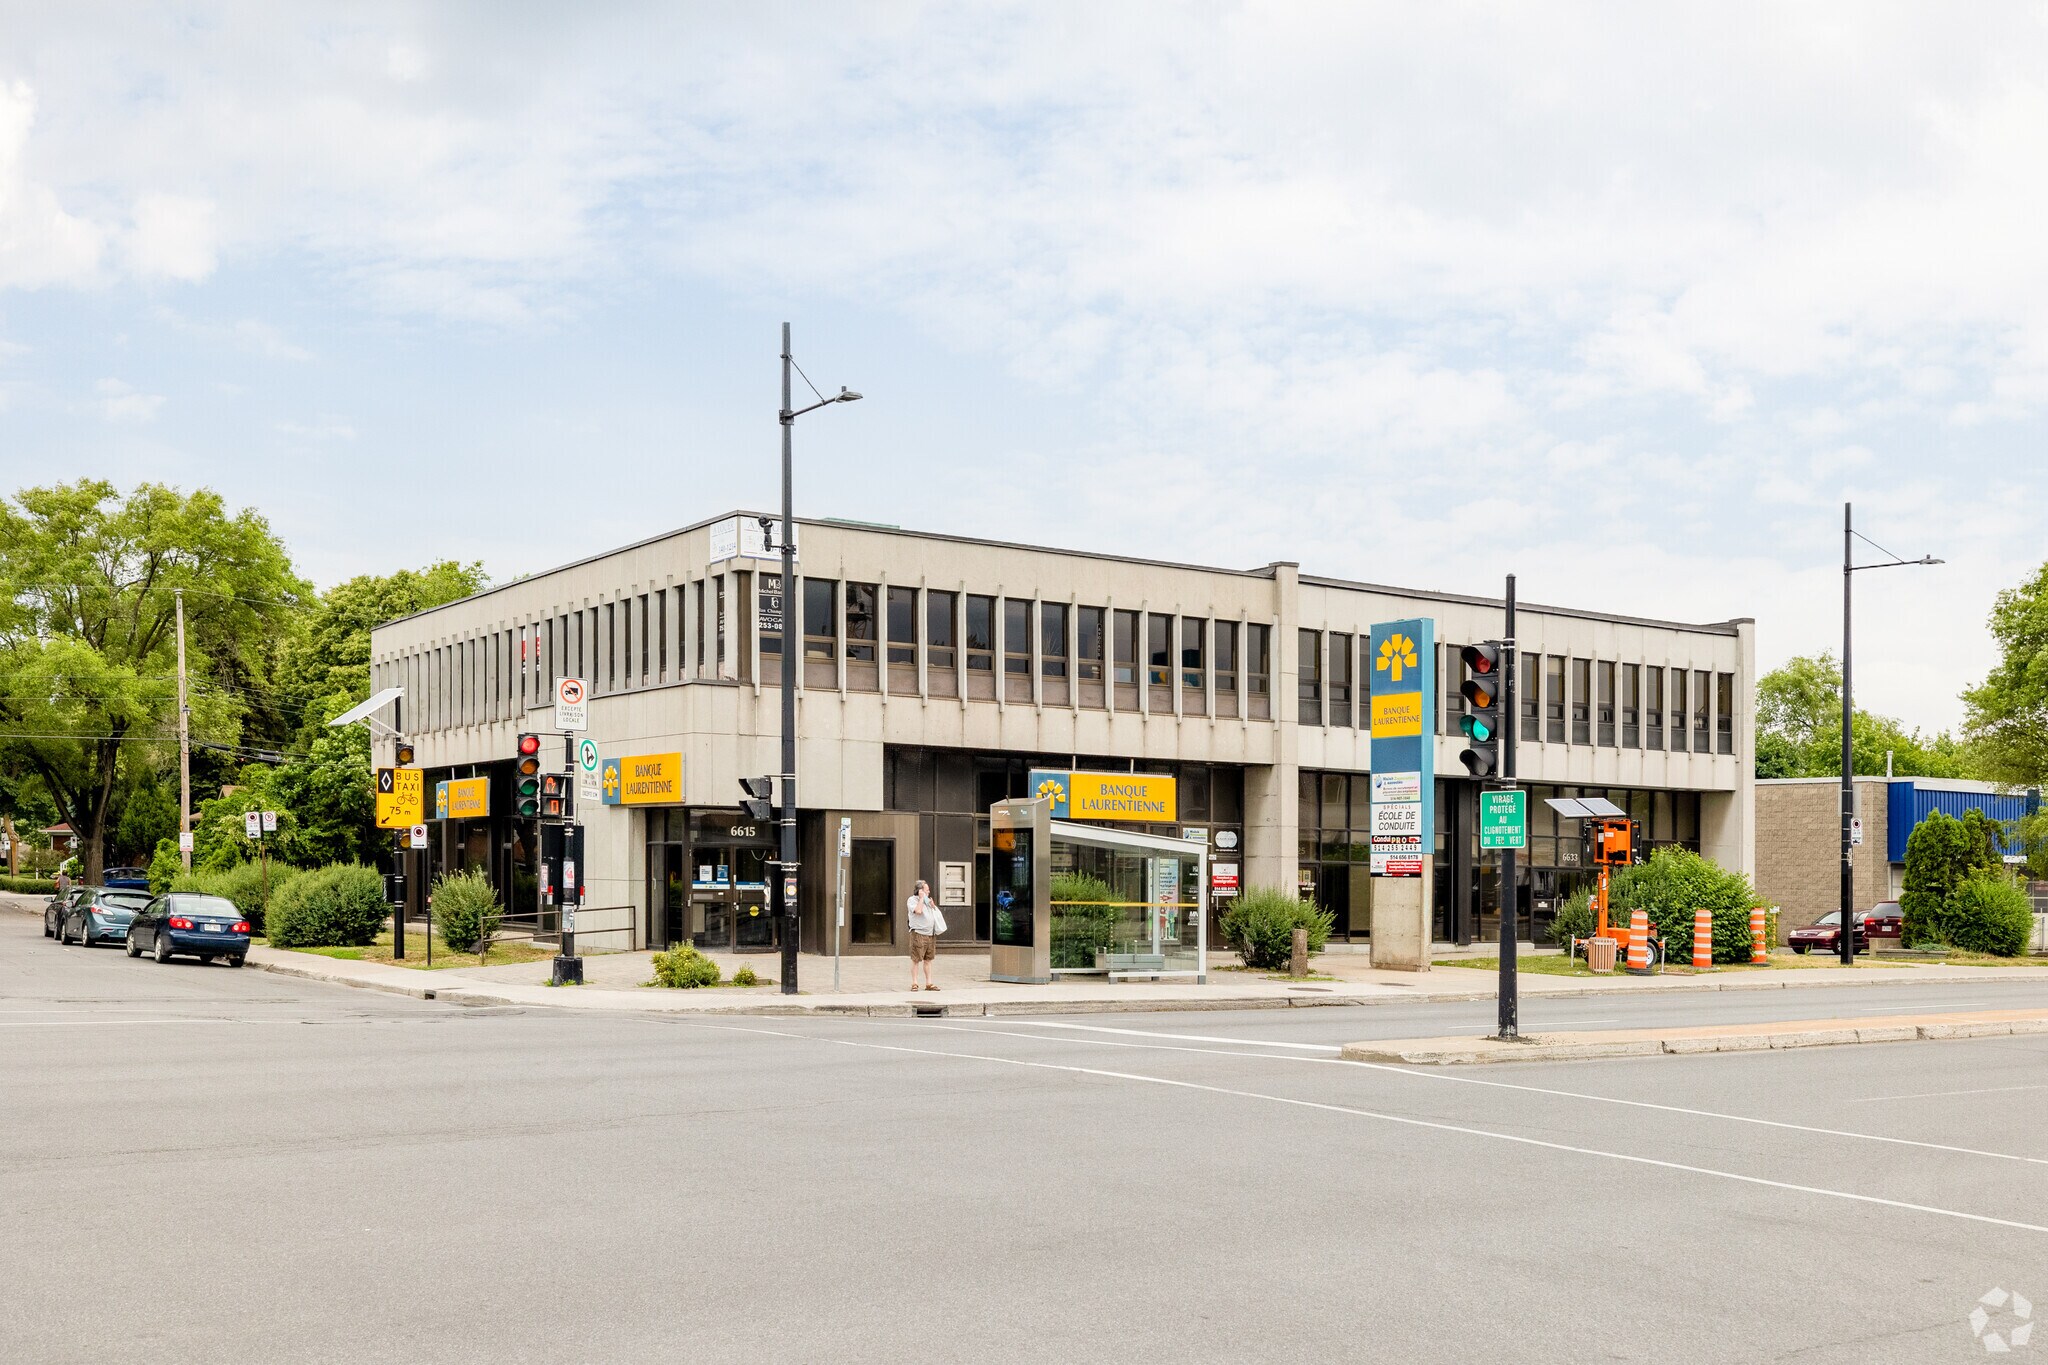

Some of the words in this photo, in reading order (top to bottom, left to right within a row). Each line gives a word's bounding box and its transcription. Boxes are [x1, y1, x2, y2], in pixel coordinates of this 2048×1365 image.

[1384, 706, 1410, 715] BANQUE
[1373, 715, 1420, 726] LAURENTIENNE
[635, 763, 662, 779] BANQUE
[396, 772, 419, 781] BUS
[396, 783, 419, 791] TAXI
[626, 780, 672, 795] LAURENTIENNE
[1100, 783, 1147, 799] BANQUE
[457, 787, 475, 799] BANQUE
[1491, 794, 1514, 803] VIRAGE
[452, 799, 480, 811] LAURENTIENNE
[1082, 798, 1165, 813] LAURENTIENNE
[1489, 803, 1516, 814] PROTÉGÉ
[389, 806, 401, 815] 75
[1378, 810, 1403, 821] ÉCOLE
[1405, 811, 1416, 820] DE
[1498, 815, 1507, 824] AU
[1378, 821, 1416, 831] CONDUITE
[1484, 825, 1521, 834] CLIGNOTEMENT
[730, 826, 756, 837] 6615
[1483, 836, 1491, 844] DU
[1495, 836, 1504, 844] FEU
[1509, 836, 1522, 844] VERT
[1374, 844, 1385, 852] 514
[1387, 844, 1398, 852] 255
[1562, 853, 1578, 861] 6633
